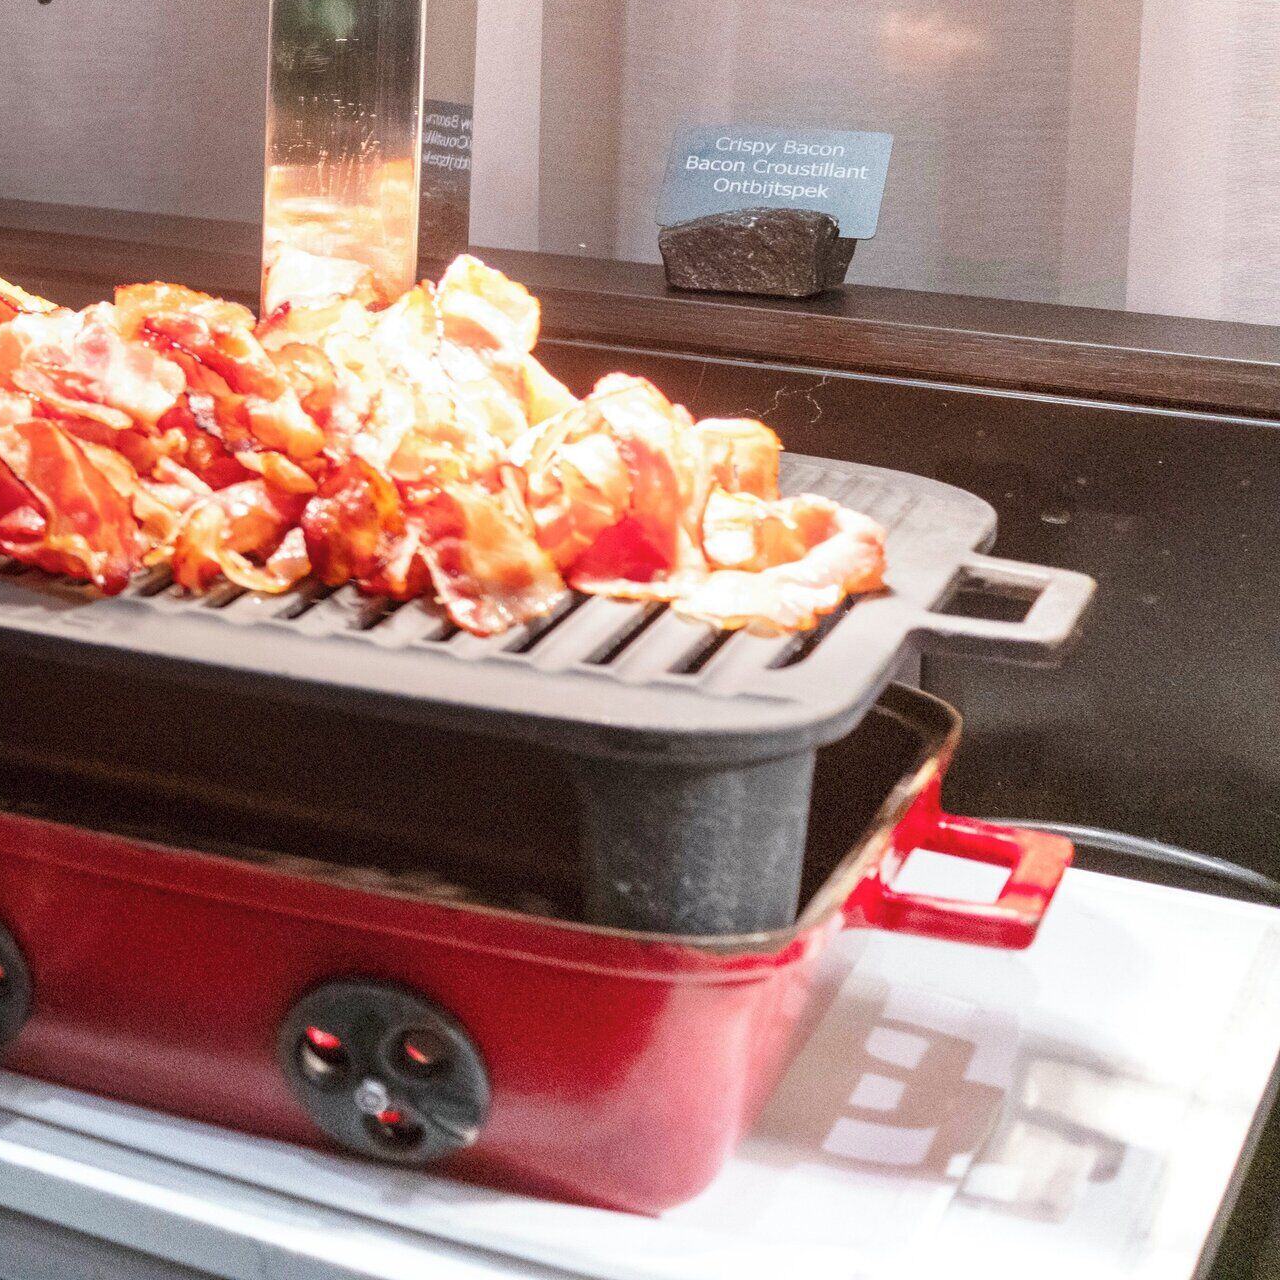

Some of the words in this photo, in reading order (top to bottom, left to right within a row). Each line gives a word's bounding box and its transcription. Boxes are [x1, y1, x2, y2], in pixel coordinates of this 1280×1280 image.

[715, 136, 777, 155] Crispy
[783, 140, 845, 157] Bacon
[685, 155, 745, 172] Bacon
[753, 159, 870, 179] Croustillant
[713, 177, 830, 200] Ontbijtspek
